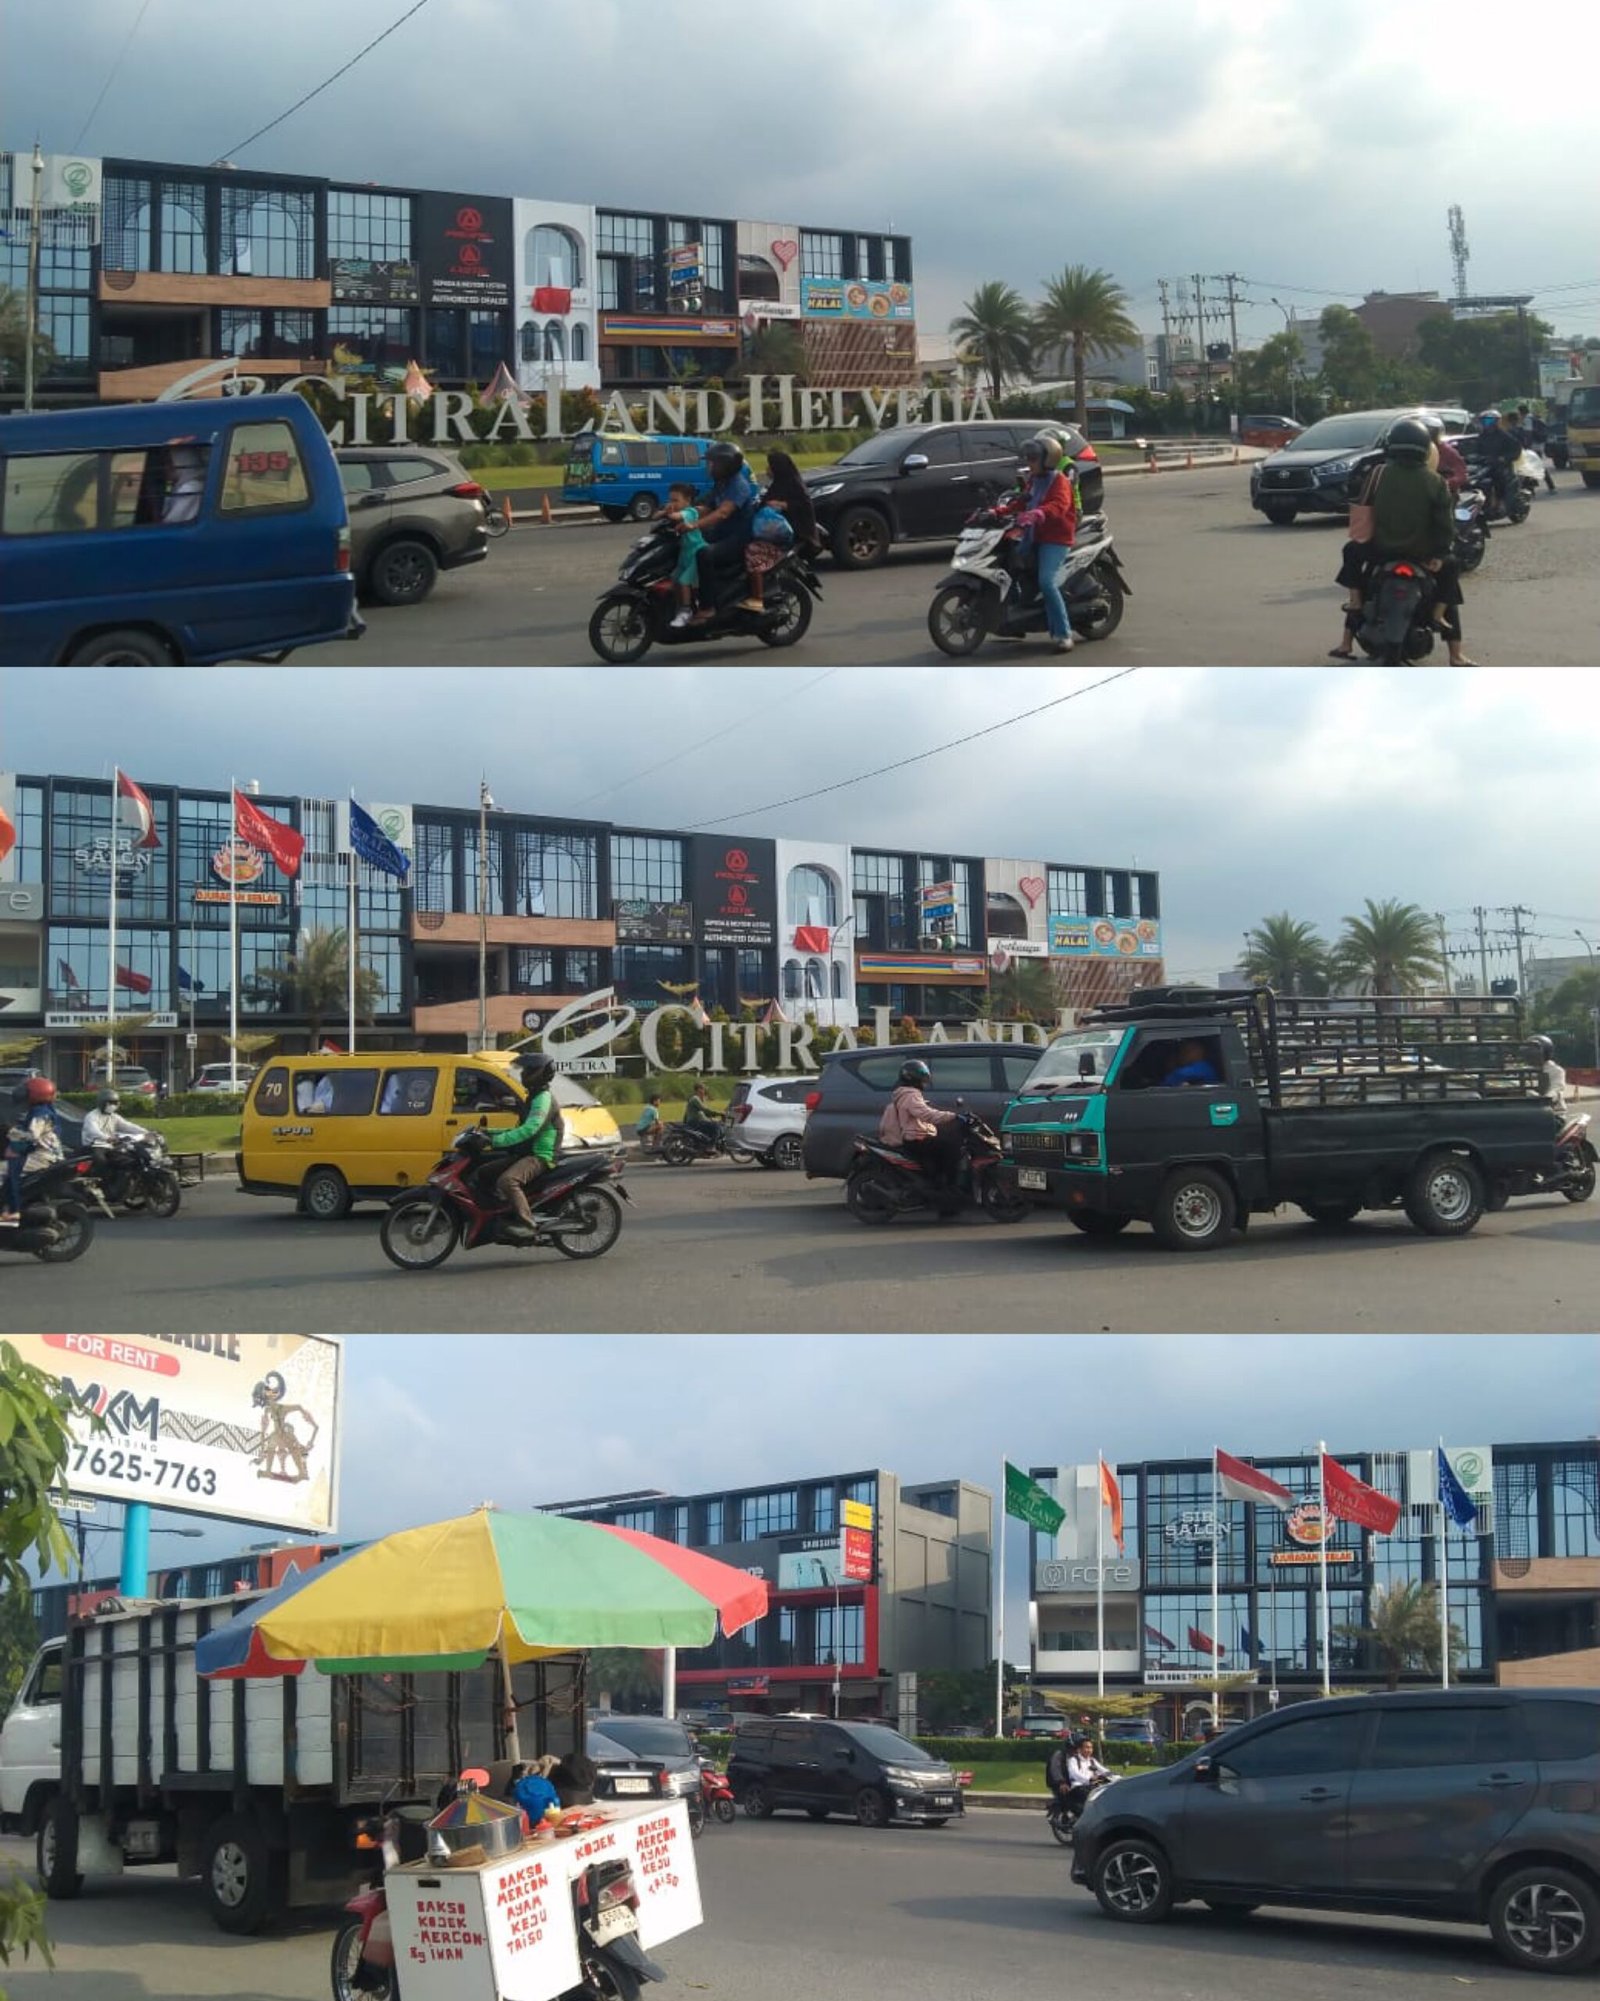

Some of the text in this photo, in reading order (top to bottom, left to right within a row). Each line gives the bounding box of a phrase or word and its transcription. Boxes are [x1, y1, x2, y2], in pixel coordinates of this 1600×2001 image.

[807, 297, 842, 310] HALAL
[1054, 935, 1089, 947] HALAL
[555, 1061, 607, 1072] IPUTRA
[265, 1082, 283, 1097] 70
[64, 1333, 106, 1358] FOR
[110, 1343, 160, 1371] RENT
[637, 1817, 670, 1836] BAKSO
[575, 1833, 616, 1861] KOJEK
[636, 1827, 677, 1853] MERCON
[640, 1844, 669, 1864] AYAM
[499, 1863, 543, 1890] BAKSO
[642, 1857, 671, 1877] KEJU
[496, 1874, 549, 1907] MERCON
[416, 1901, 466, 1915] BAKSO
[507, 1895, 543, 1921] AYAM
[417, 1916, 468, 1928] KOJEK
[511, 1908, 548, 1936] KEJU
[409, 1947, 426, 1963] By
